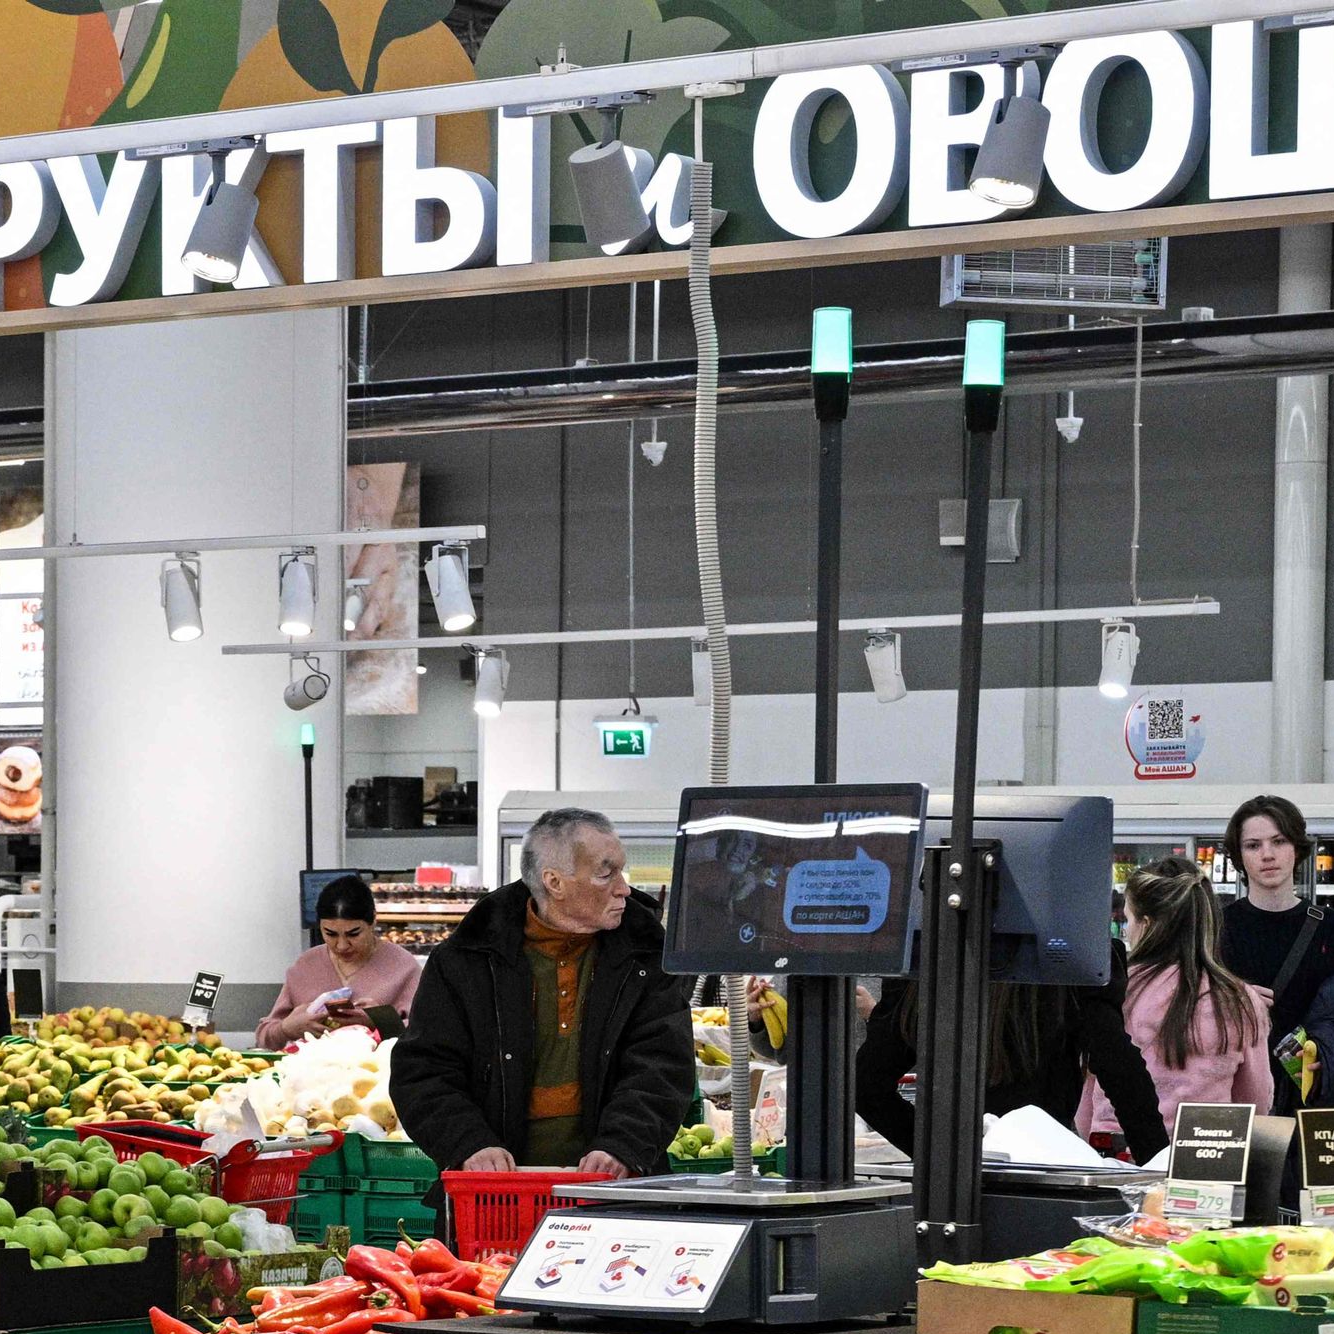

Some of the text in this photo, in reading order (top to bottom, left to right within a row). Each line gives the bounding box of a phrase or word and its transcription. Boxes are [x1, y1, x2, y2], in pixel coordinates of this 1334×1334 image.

[823, 811, 891, 823] ПЛЮ
[1192, 1127, 1233, 1138] Томаты
[1176, 1139, 1247, 1150] сливовидные
[1195, 1149, 1217, 1160] 600
[1198, 1195, 1224, 1210] 279
[548, 1222, 592, 1232] dataprint
[261, 1262, 308, 1284] КАЗАЧИЙ
